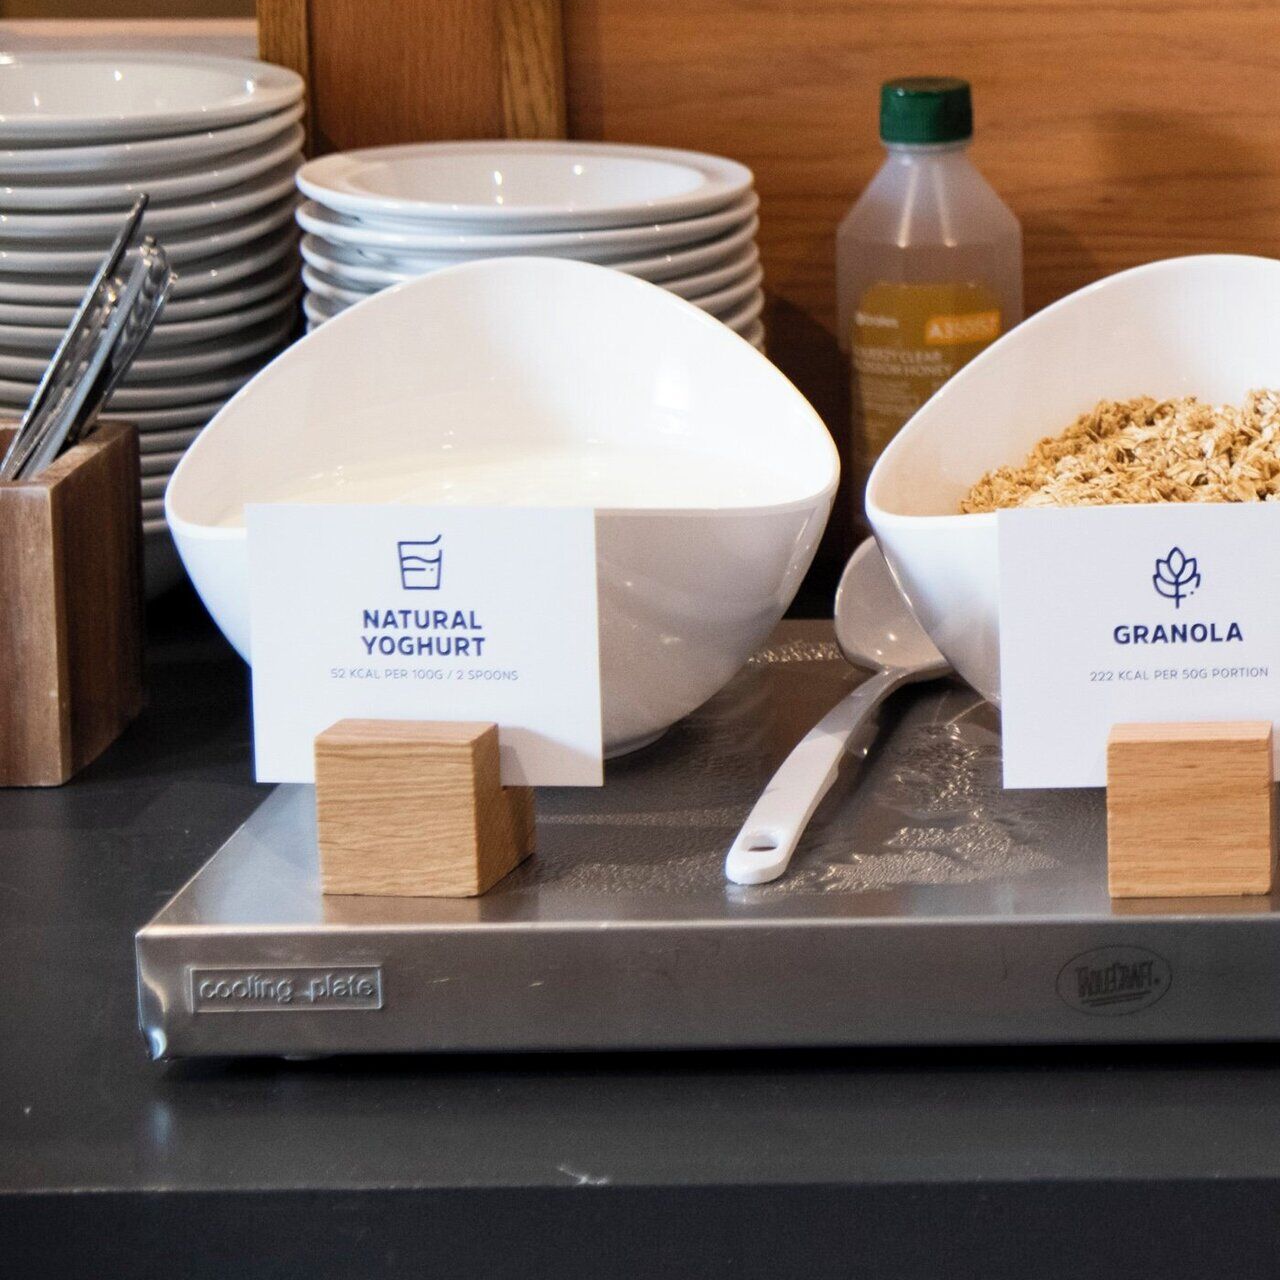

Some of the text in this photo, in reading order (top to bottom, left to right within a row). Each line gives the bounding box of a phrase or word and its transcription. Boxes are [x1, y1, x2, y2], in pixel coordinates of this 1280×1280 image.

[362, 609, 483, 630] NATURAL
[1113, 622, 1244, 645] GRANOLA
[361, 635, 487, 657] YOGHURT
[330, 668, 346, 679] 52
[349, 668, 381, 680] KCAL
[384, 669, 409, 680] PER
[412, 669, 444, 680] 100G
[456, 670, 464, 680] 2
[467, 670, 519, 681] SPOONS
[1089, 667, 1269, 682] 222 KCAL PER 50G PORTION
[200, 973, 373, 1002] cooling plate
